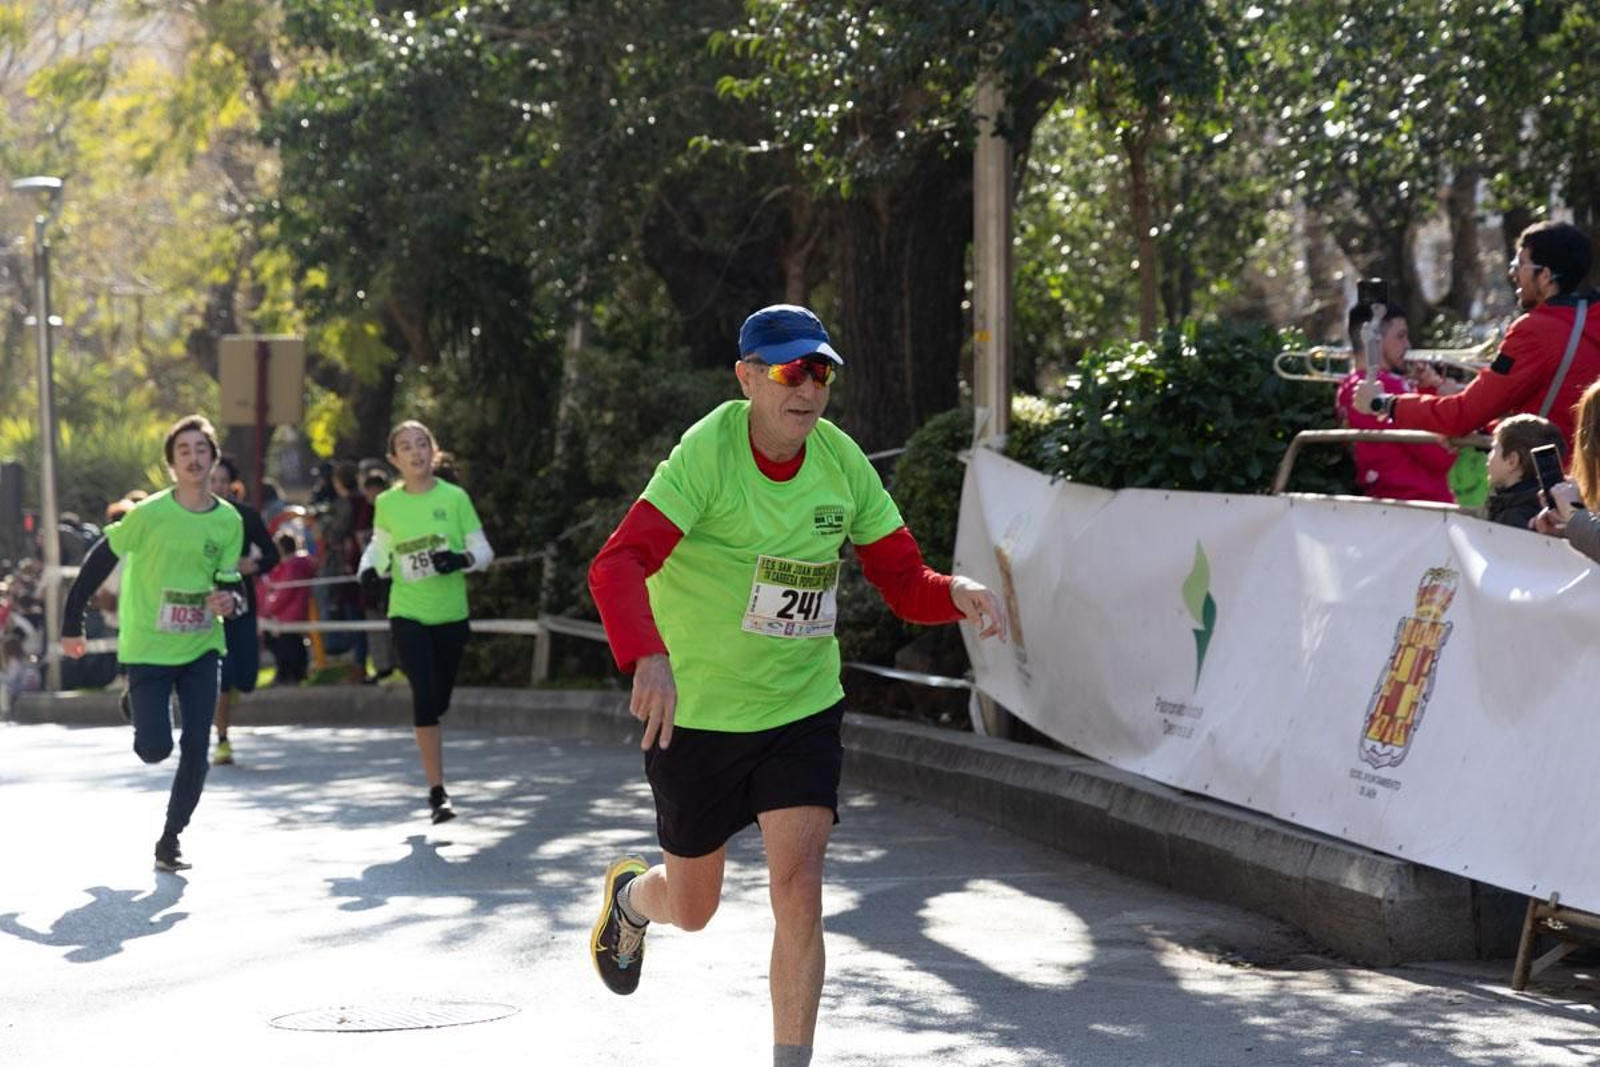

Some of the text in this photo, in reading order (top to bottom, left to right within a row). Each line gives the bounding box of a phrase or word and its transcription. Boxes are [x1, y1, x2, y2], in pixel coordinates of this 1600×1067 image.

[778, 561, 792, 573] SAN
[792, 564, 812, 576] JUAN
[776, 589, 824, 621] 241
